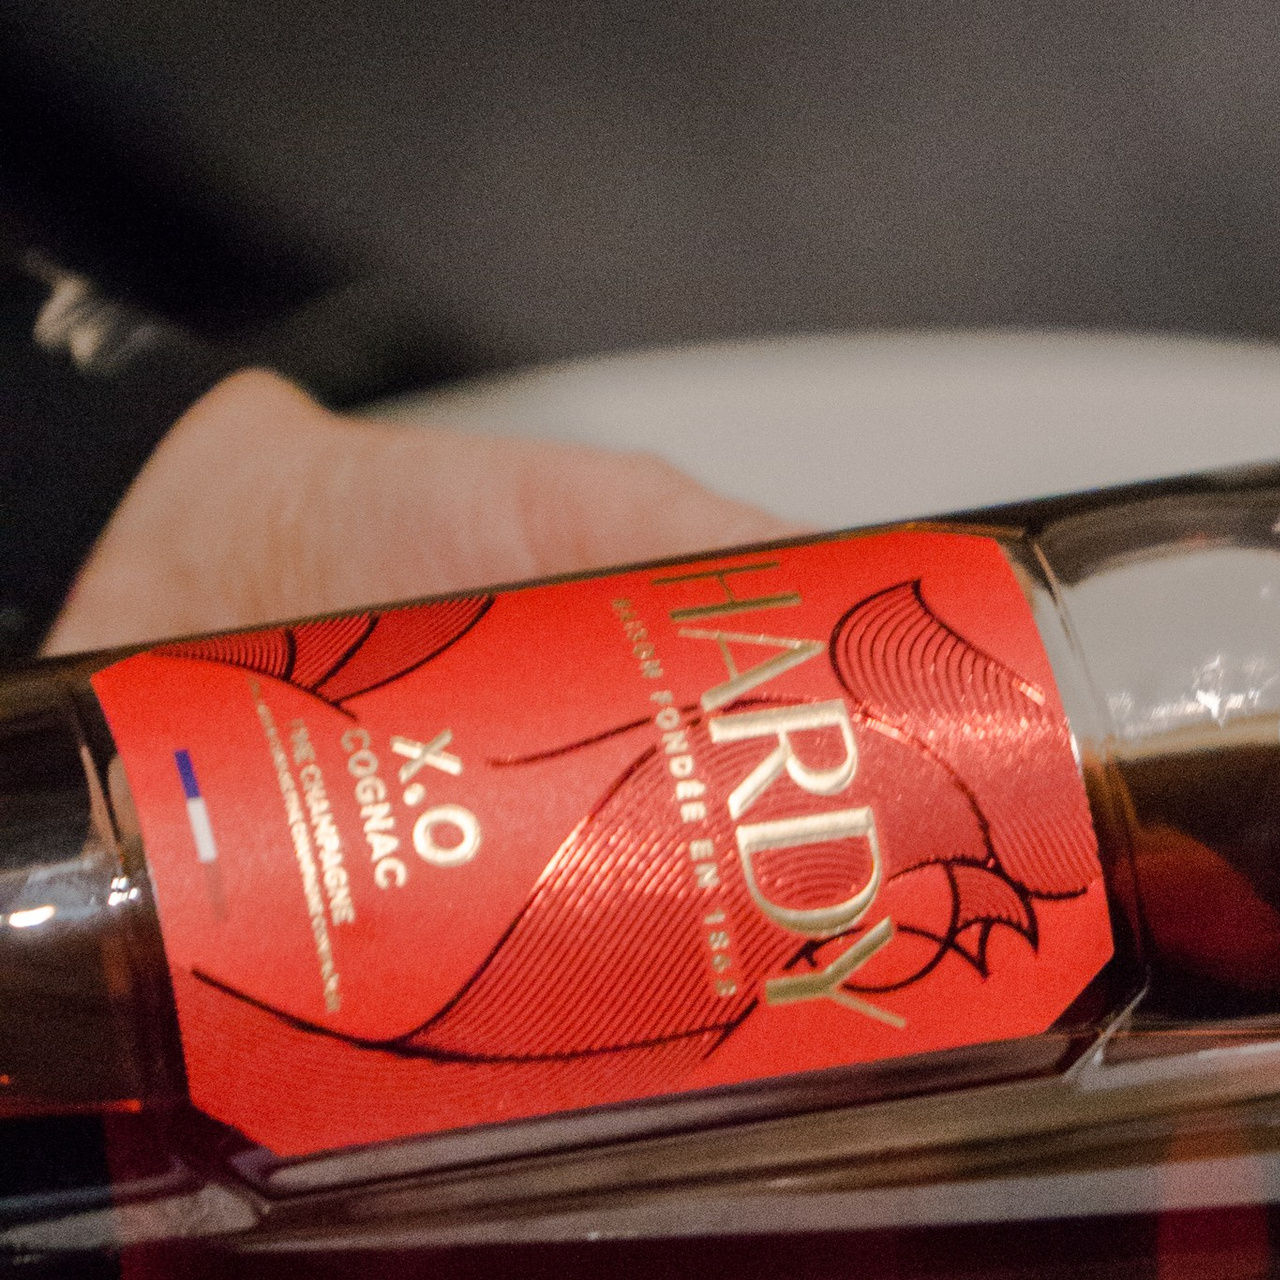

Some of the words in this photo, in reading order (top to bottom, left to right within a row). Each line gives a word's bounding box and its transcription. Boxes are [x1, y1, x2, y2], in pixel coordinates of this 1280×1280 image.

[301, 765, 355, 925] CHAMPAGNE
[341, 728, 408, 889] COGNAC
[390, 729, 481, 867] X.O
[650, 690, 706, 822] FONDÉE
[690, 839, 720, 889] EN
[651, 561, 905, 1028] HARDY
